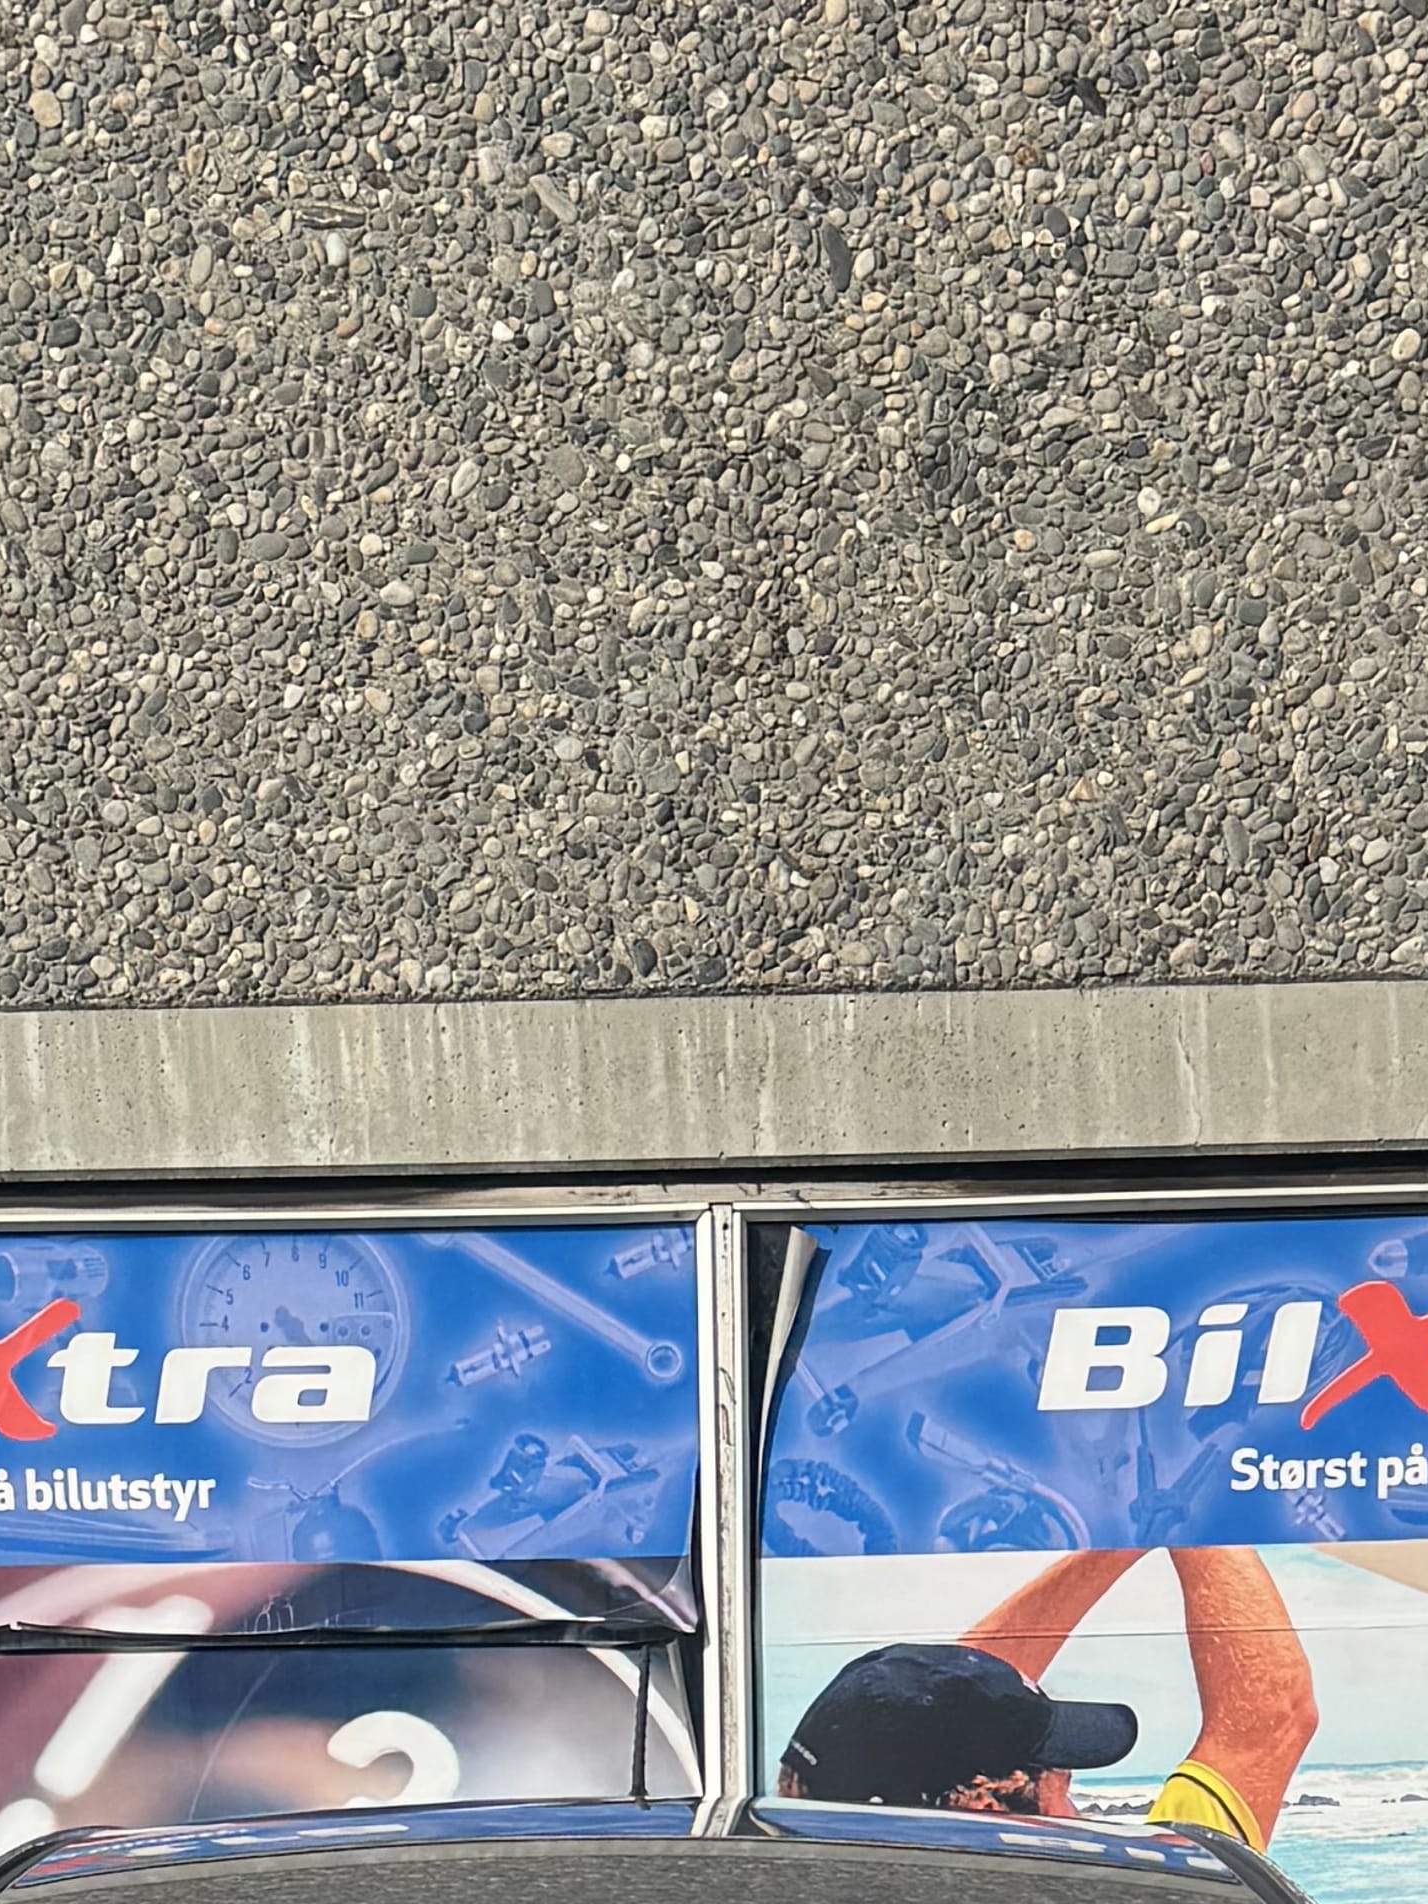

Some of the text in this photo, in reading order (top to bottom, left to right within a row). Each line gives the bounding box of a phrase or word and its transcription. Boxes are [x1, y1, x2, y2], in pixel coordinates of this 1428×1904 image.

[243, 1264, 251, 1280] 6
[336, 1270, 349, 1287] 10
[226, 1289, 234, 1304] 5
[354, 1292, 364, 1308] 11
[1230, 1447, 1367, 1491] Størst
[1377, 1443, 1428, 1499] på
[26, 1467, 216, 1522] bilutstyr
